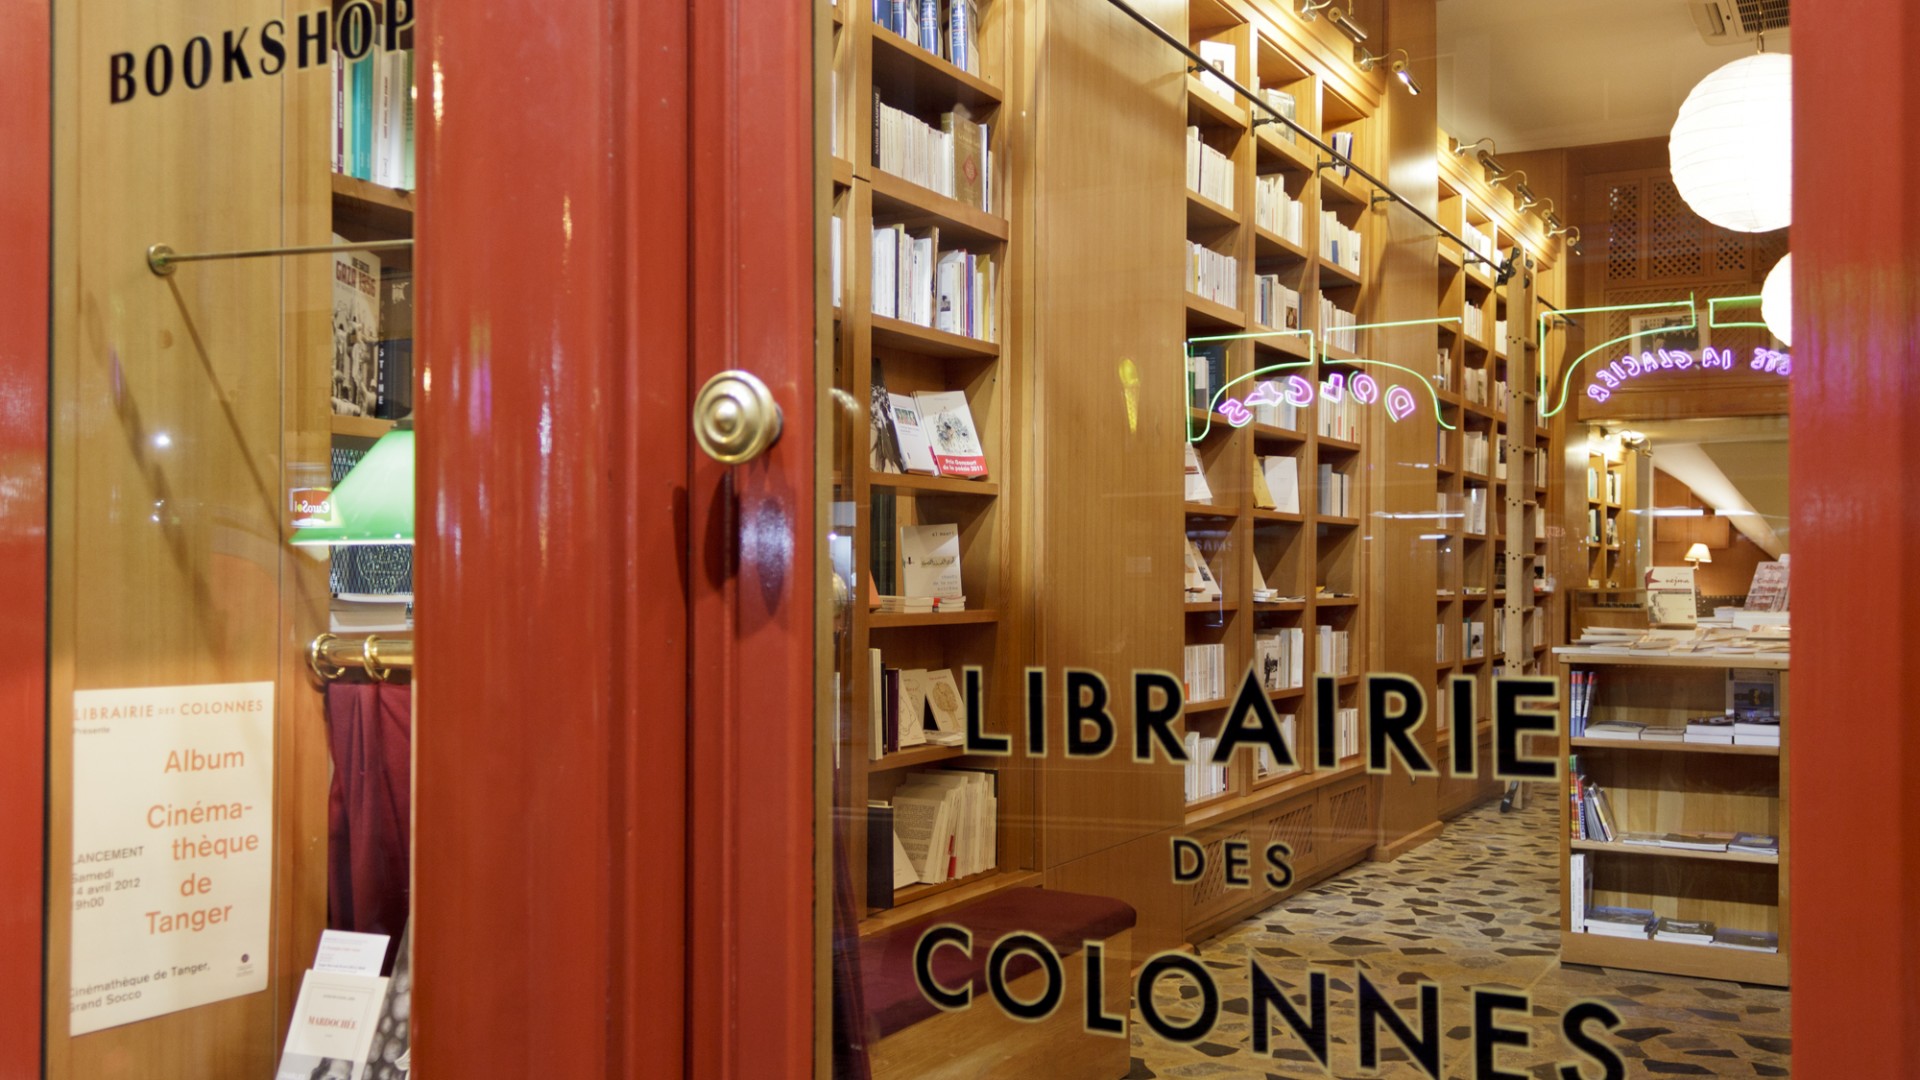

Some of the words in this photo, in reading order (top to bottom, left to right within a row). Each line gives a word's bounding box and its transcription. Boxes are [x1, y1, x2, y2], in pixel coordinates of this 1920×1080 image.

[109, 0, 414, 105] BOOKSHOP
[336, 260, 356, 289] GAZA
[73, 705, 154, 721] LIBRAIRIE
[179, 700, 263, 716] COLONNES
[963, 662, 1560, 781] LIBRAIRIE
[164, 748, 244, 774] Album
[147, 800, 253, 830] Cinéma-
[171, 833, 259, 862] thèque
[1171, 836, 1294, 890] DES
[87, 882, 112, 896] avril
[114, 878, 141, 891] 2012
[180, 873, 212, 897] de
[145, 904, 233, 936] Tanger
[153, 969, 168, 982] de
[106, 989, 142, 1006] Socco
[913, 922, 1627, 1080] COLONNES
